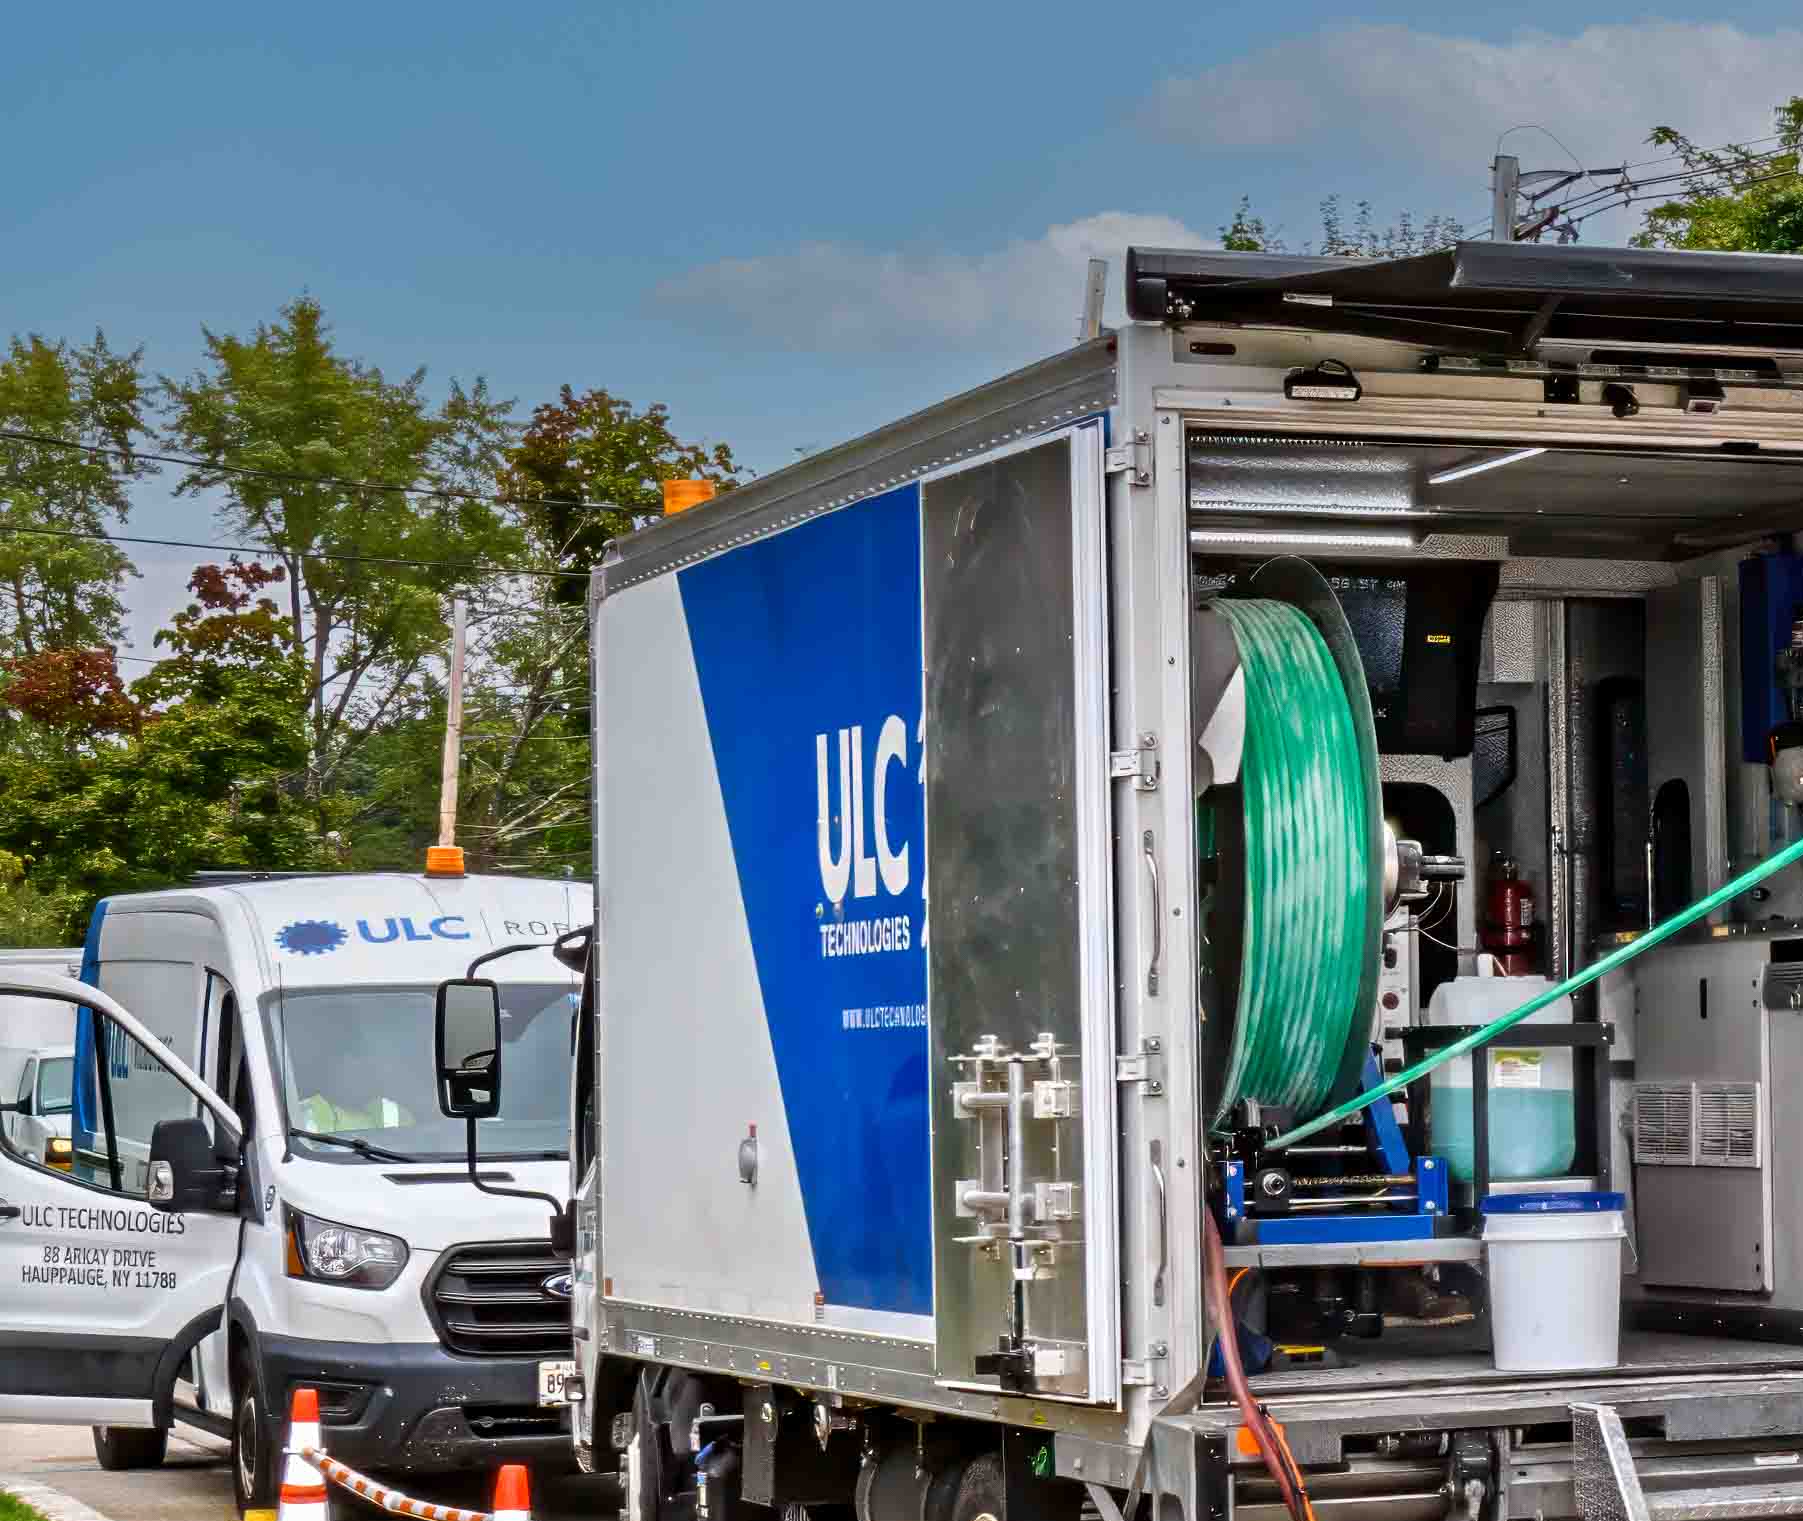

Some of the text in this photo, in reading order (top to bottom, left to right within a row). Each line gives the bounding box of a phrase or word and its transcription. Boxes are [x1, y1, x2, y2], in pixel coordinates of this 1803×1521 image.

[816, 715, 910, 903] ULC
[355, 916, 471, 944] ULC
[820, 915, 911, 957] TECHNOLOGIES
[22, 1205, 185, 1235] ULC TECHNOLOGIES
[43, 1246, 157, 1268] 88 ARKAY DRIVE
[22, 1264, 178, 1290] HAUPPAUGE, NY 11788
